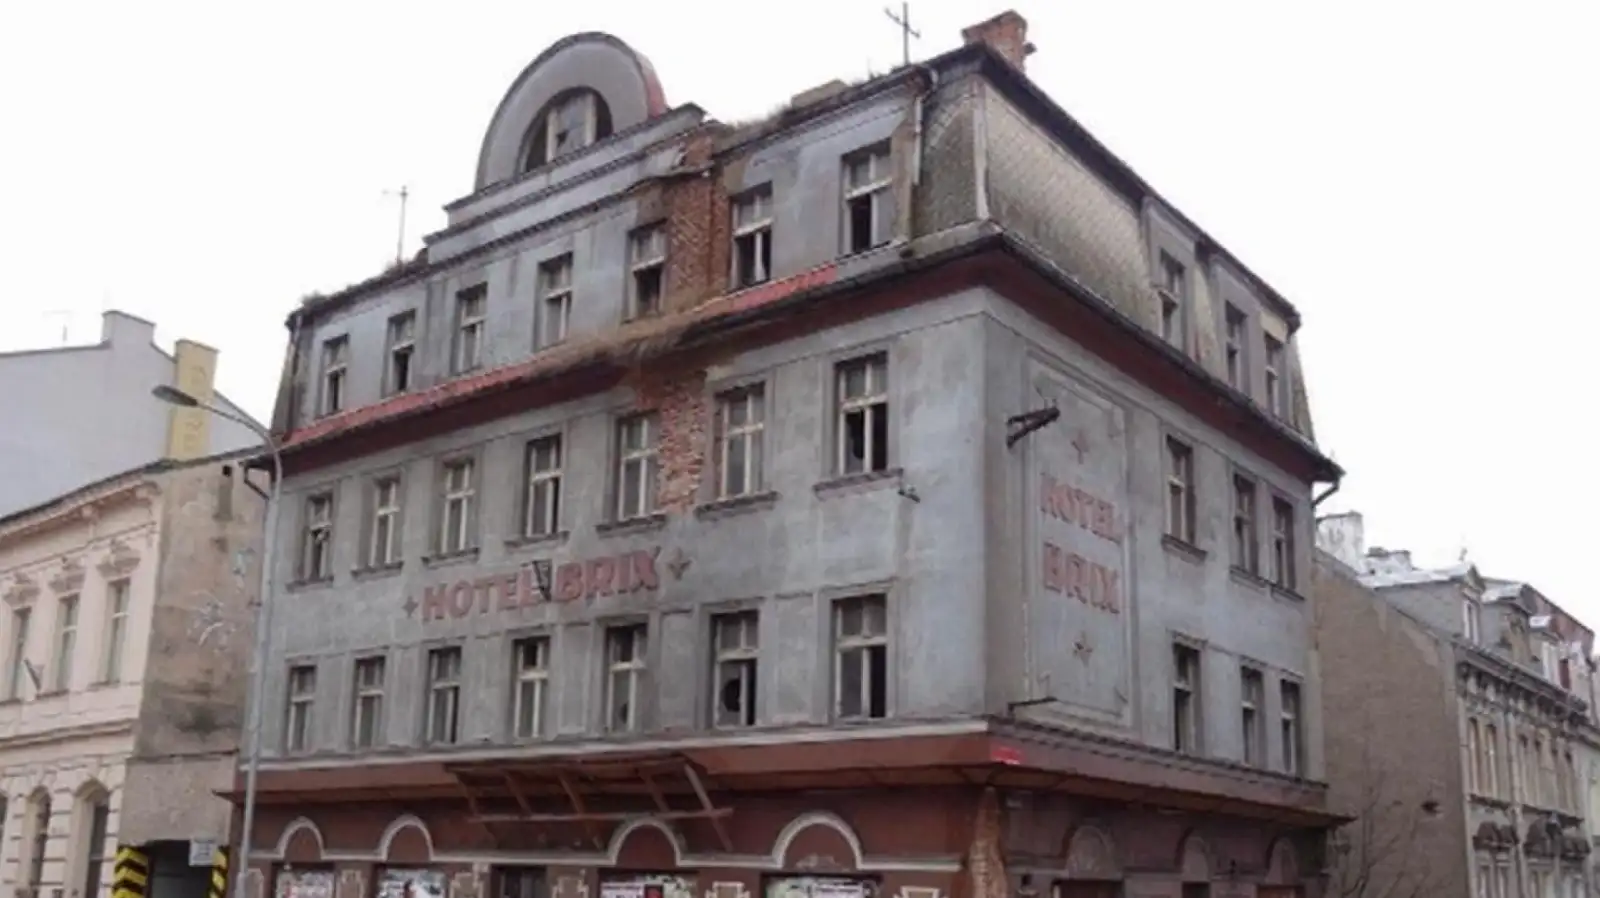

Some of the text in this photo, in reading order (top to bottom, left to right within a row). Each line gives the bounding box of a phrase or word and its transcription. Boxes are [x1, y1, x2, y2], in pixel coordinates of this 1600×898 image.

[1040, 472, 1121, 544] HOTEL
[421, 547, 661, 621] HOTEL BRIX
[1043, 542, 1120, 614] BRIX
